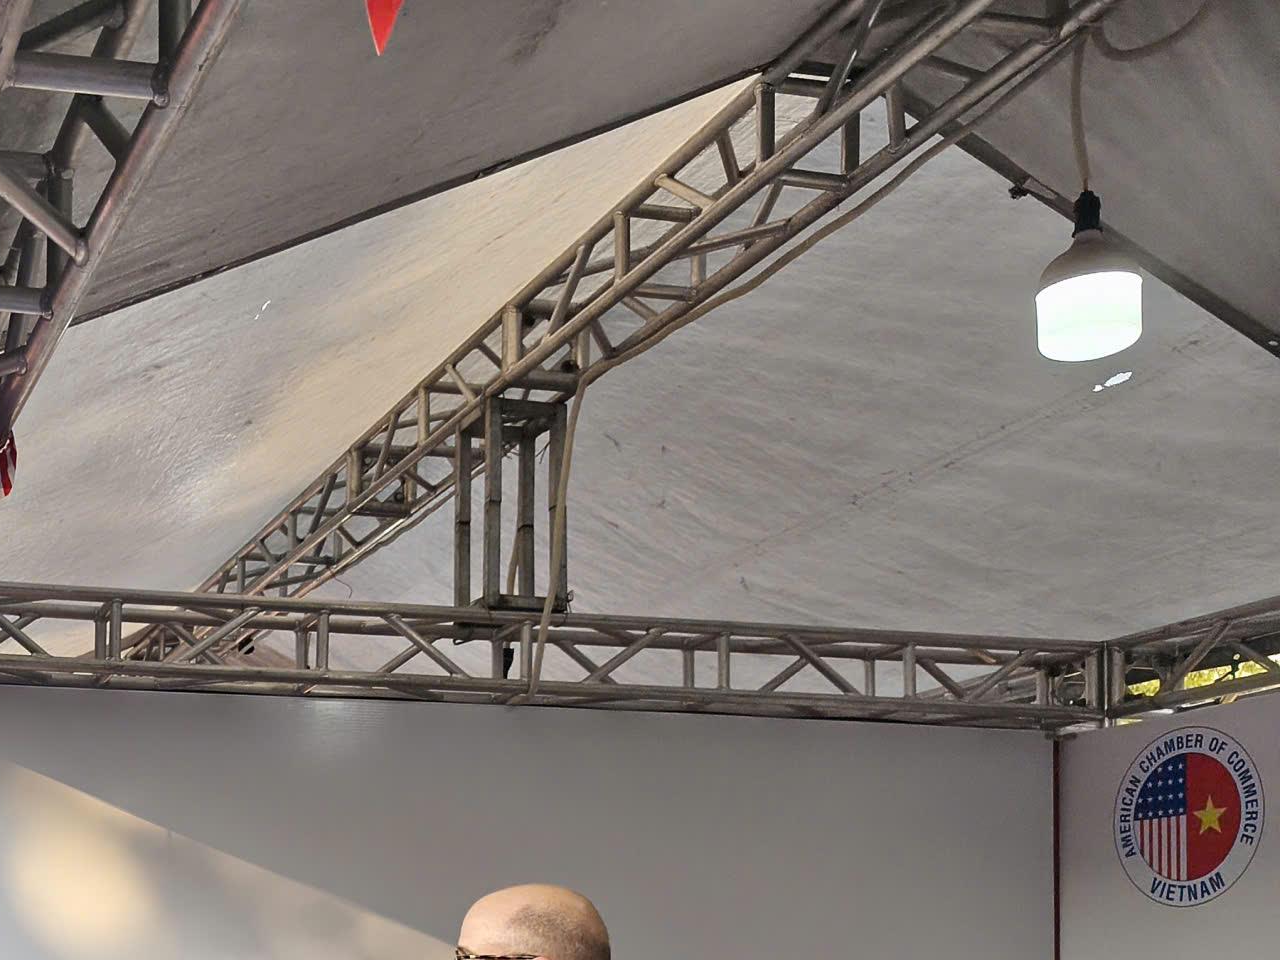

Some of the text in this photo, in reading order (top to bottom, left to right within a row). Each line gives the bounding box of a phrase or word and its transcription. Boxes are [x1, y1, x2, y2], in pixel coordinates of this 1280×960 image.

[1119, 733, 1259, 858] AMERICAN CHAMBER OF COMMERCE
[1150, 872, 1226, 902] VIETNAM
